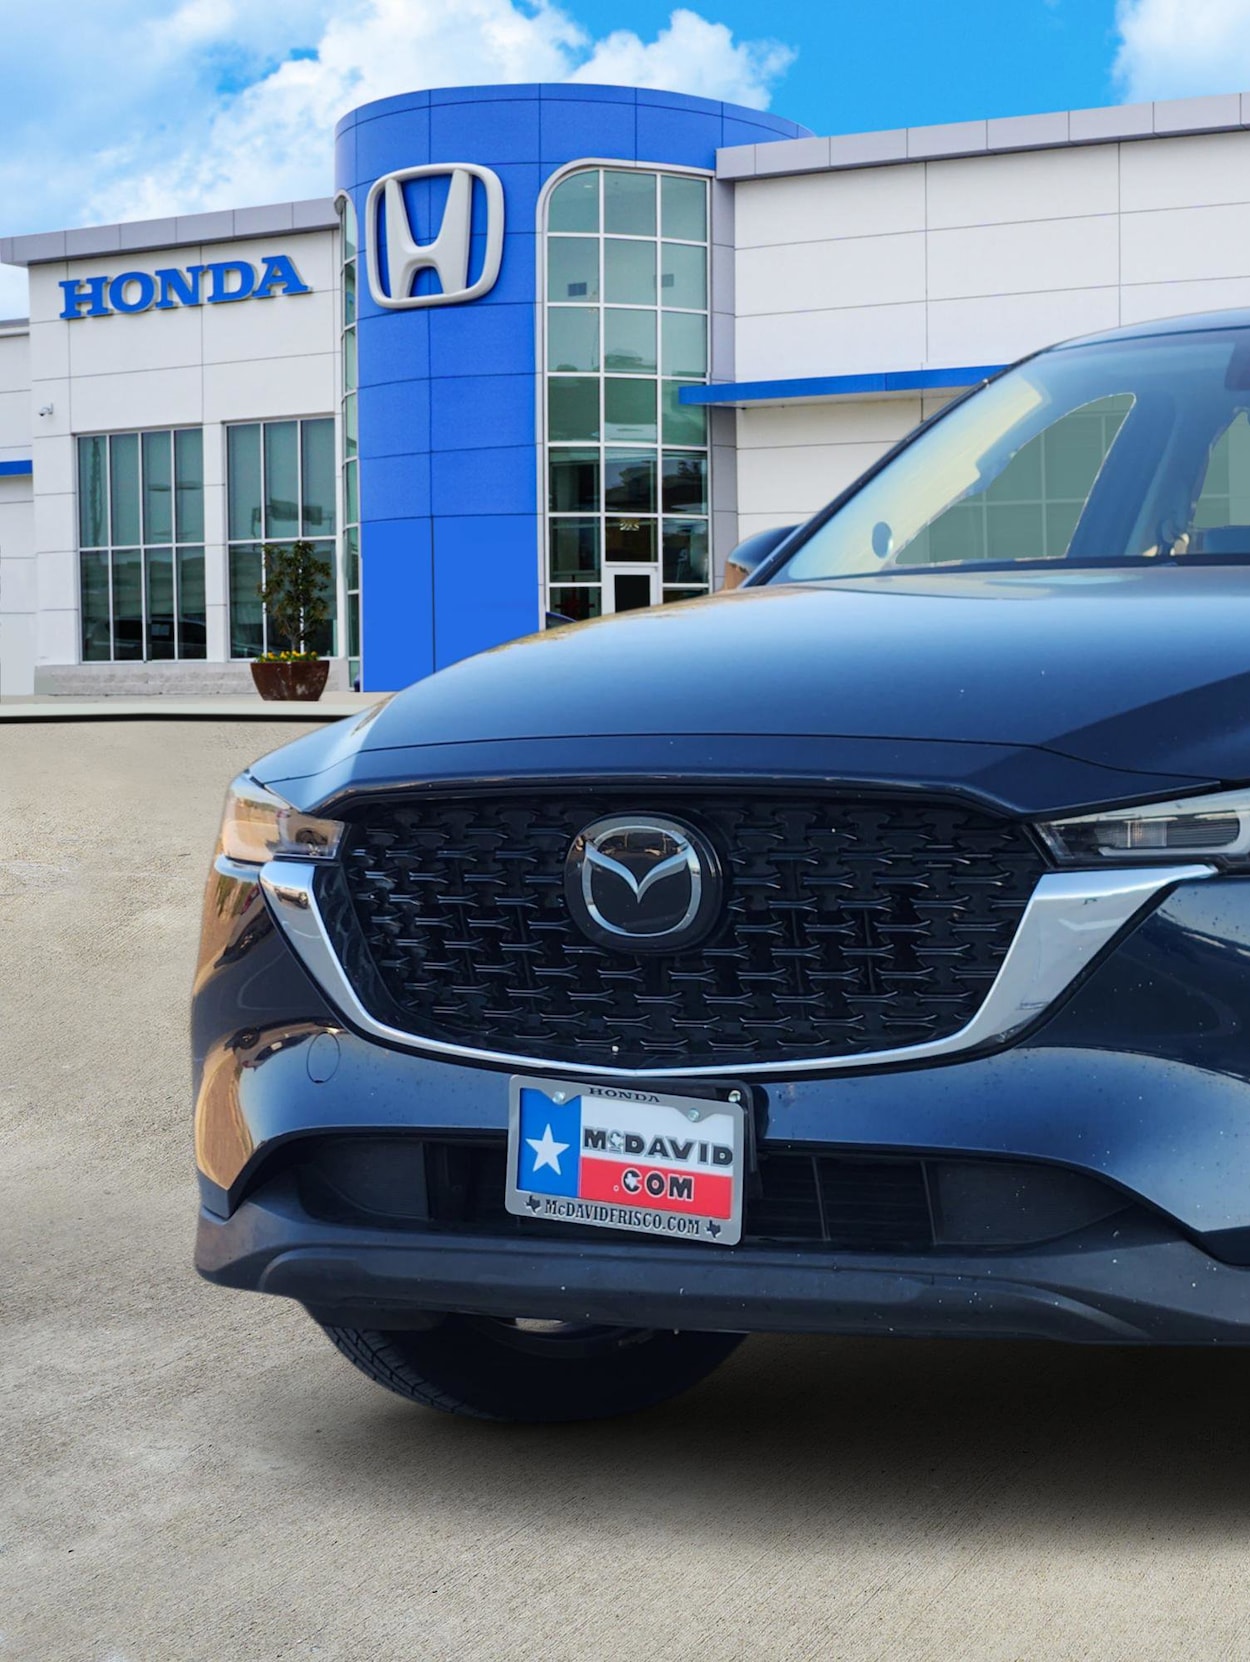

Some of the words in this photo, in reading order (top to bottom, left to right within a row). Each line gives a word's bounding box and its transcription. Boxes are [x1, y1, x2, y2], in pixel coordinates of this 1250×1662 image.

[59, 254, 311, 319] HONDA
[588, 1087, 660, 1103] HONDA
[613, 1168, 694, 1202] .COM
[545, 1199, 700, 1235] McDAVIDFRISCO.COM
